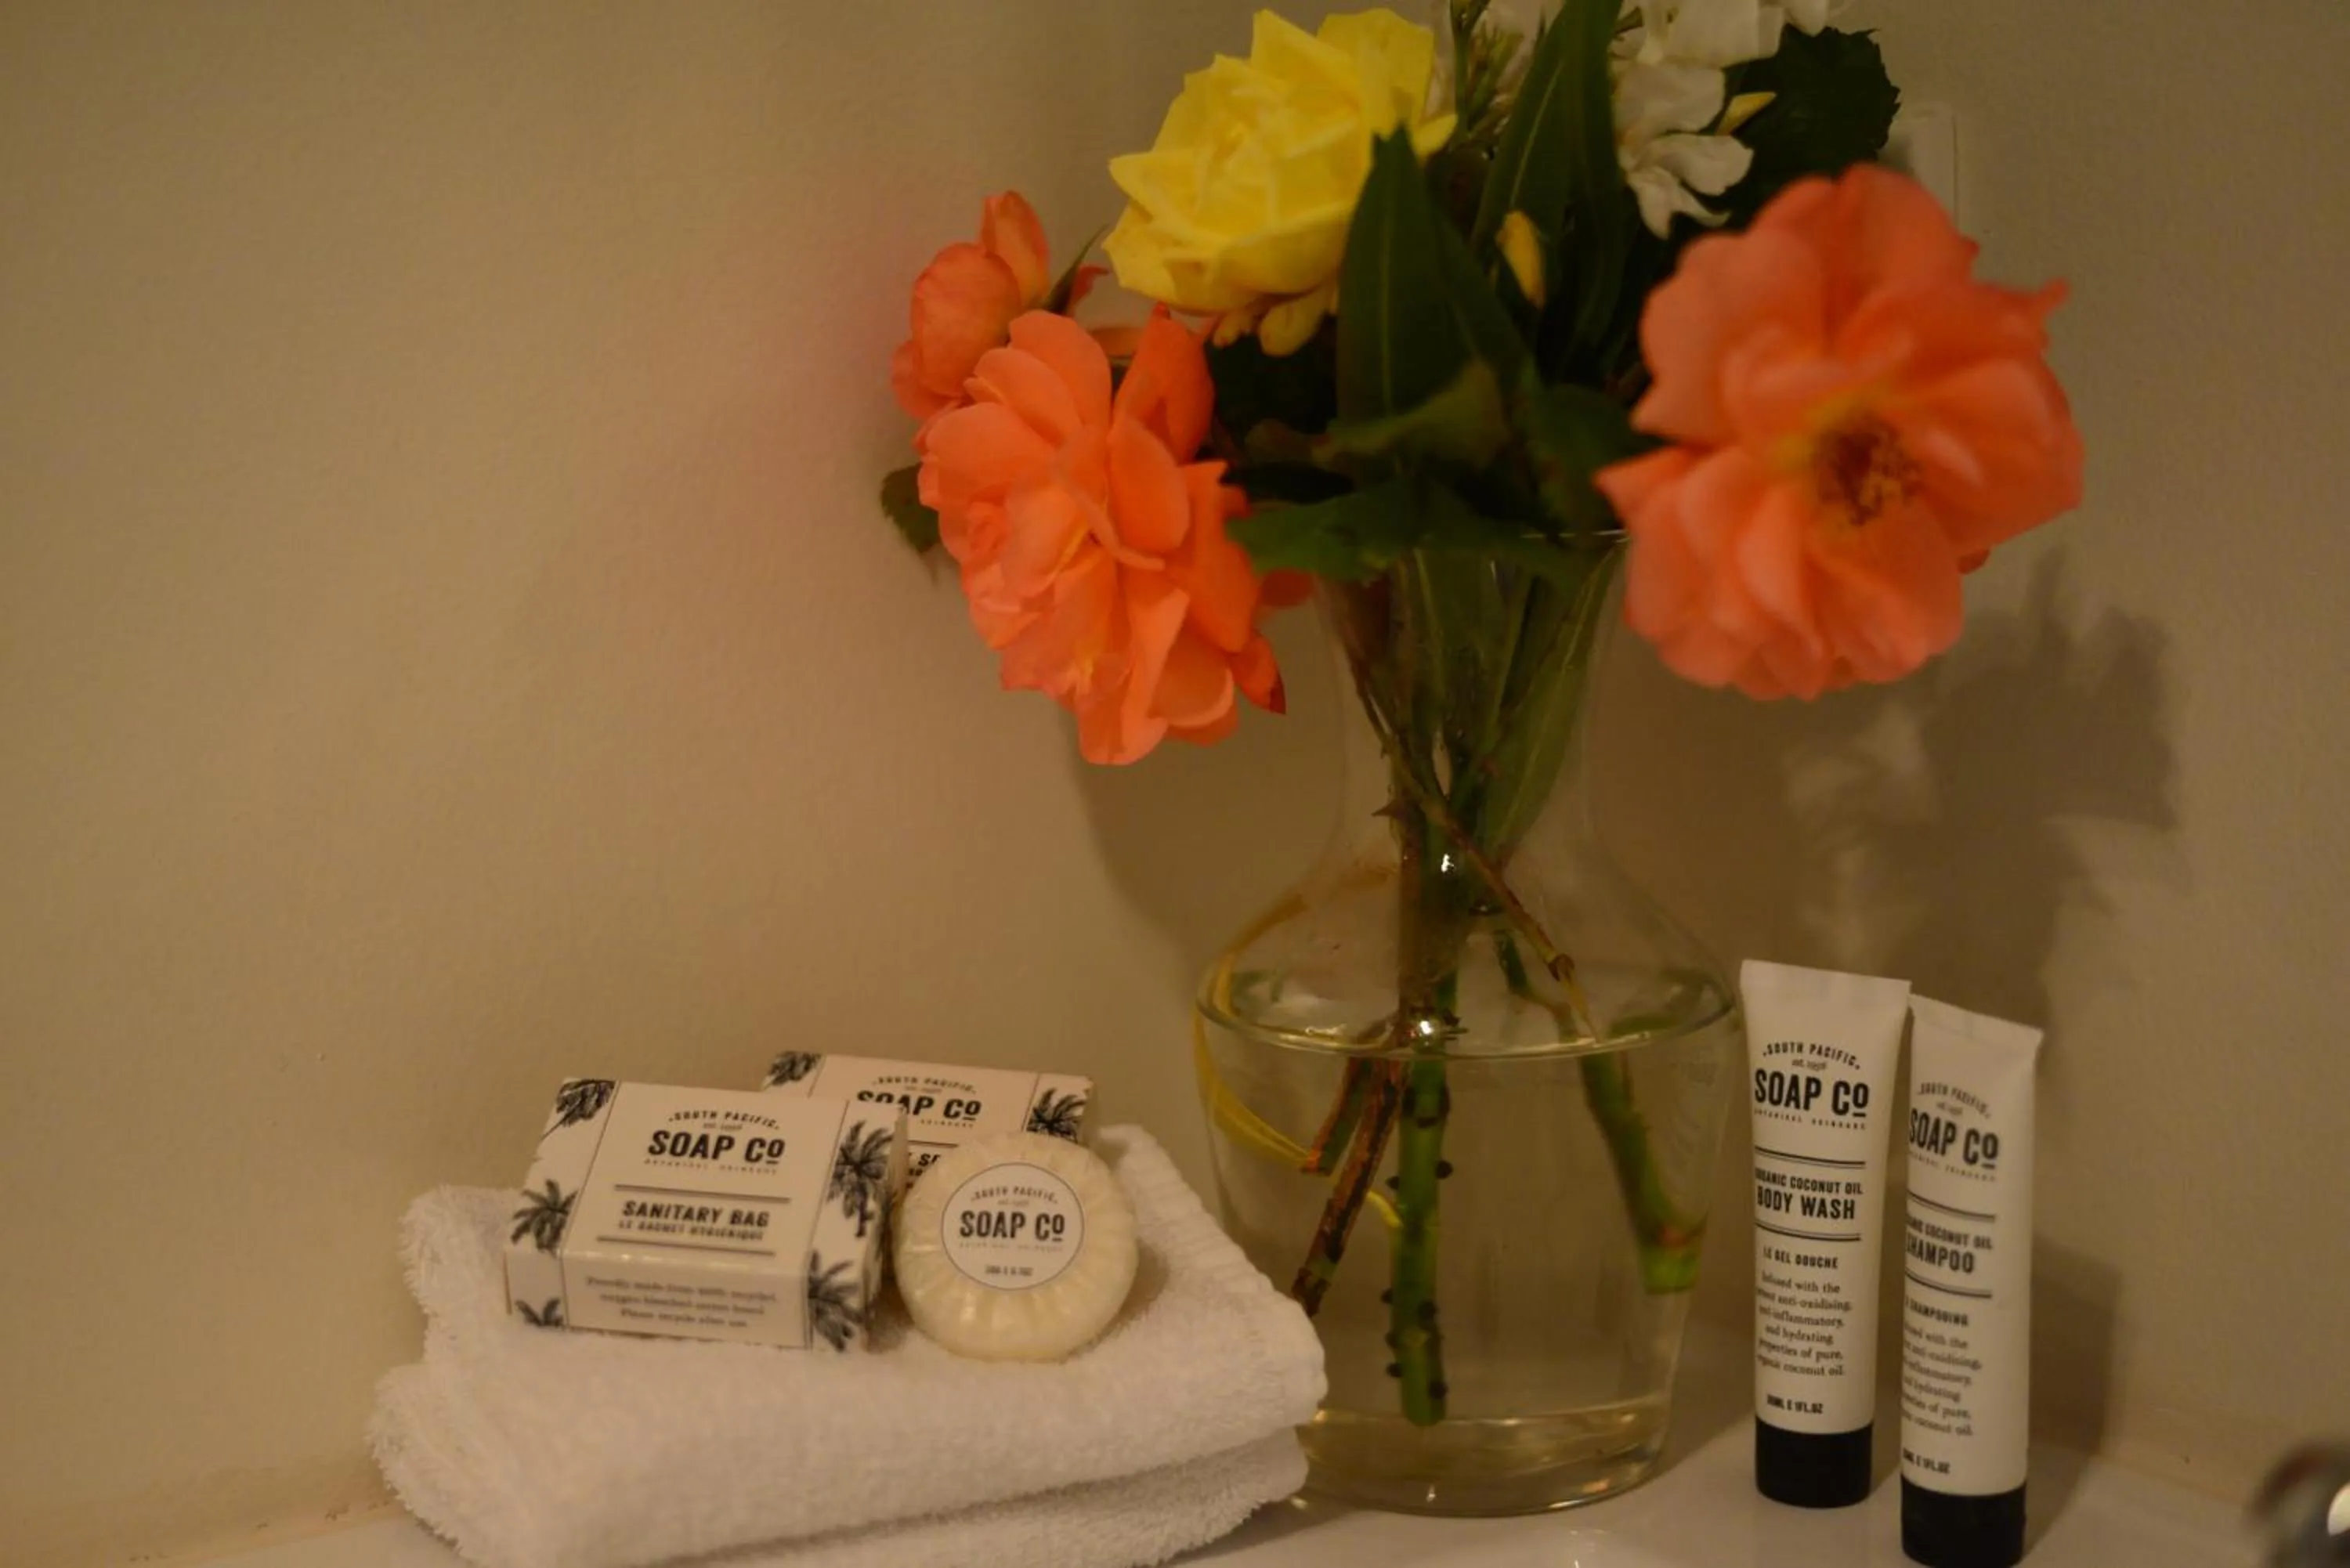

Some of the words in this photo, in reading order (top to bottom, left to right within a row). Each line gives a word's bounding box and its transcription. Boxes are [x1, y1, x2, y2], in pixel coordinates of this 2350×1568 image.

[1767, 1041, 1804, 1056] SOUTH
[1809, 1042, 1856, 1067] PACIFIC
[1755, 1068, 1822, 1111] SOAP
[674, 1110, 718, 1122] SOUTH
[725, 1111, 777, 1128] PACIFIC
[1910, 1107, 1957, 1157] SOAP
[648, 1129, 736, 1161] SOAP
[1789, 1175, 1841, 1194] COCONUT
[1845, 1181, 1864, 1195] OIL
[623, 1200, 723, 1225] SANITARY
[729, 1209, 770, 1228] BAG
[1757, 1185, 1793, 1214] BODY
[1800, 1194, 1855, 1220] WASH
[960, 1210, 1027, 1239] SOAP
[1795, 1253, 1838, 1270] DOUCHE
[1795, 1280, 1818, 1292] with
[1823, 1281, 1841, 1294] the
[1800, 1346, 1813, 1359] of
